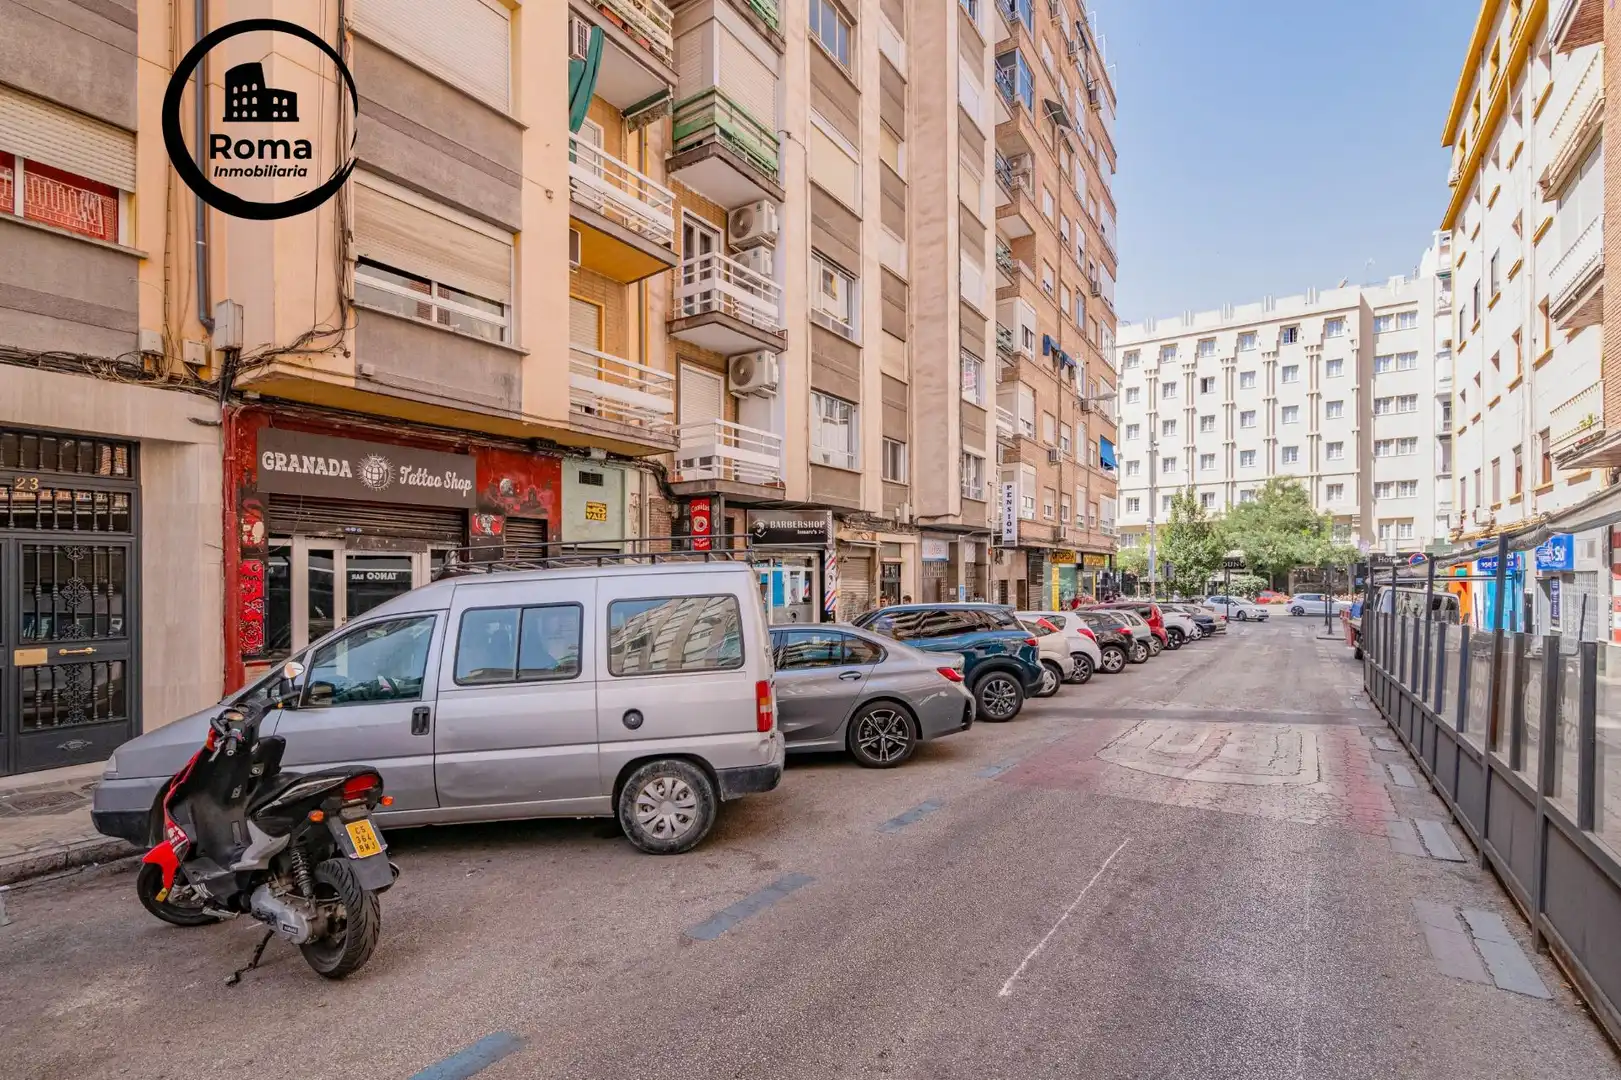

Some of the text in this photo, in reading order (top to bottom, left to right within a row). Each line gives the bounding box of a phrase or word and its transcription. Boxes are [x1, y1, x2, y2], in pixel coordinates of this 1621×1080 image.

[262, 451, 473, 497] GRANADA Tattoo Shop
[15, 477, 39, 490] 23
[770, 520, 825, 529] BARBERSHOP
